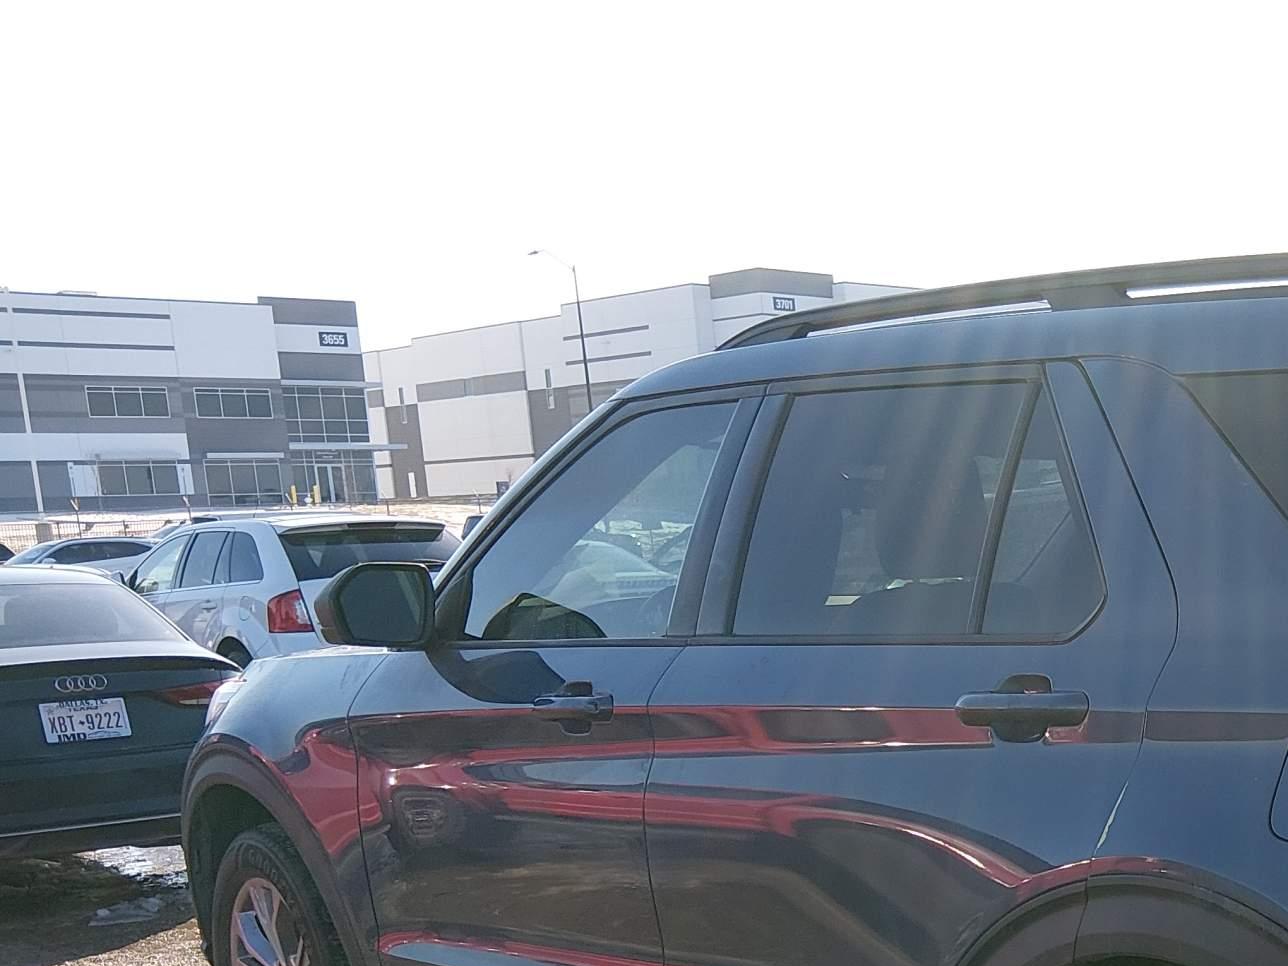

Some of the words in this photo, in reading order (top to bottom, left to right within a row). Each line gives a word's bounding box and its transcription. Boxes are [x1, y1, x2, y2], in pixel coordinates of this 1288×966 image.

[775, 299, 793, 310] 3701
[321, 333, 345, 345] 3655
[86, 711, 124, 730] 9222
